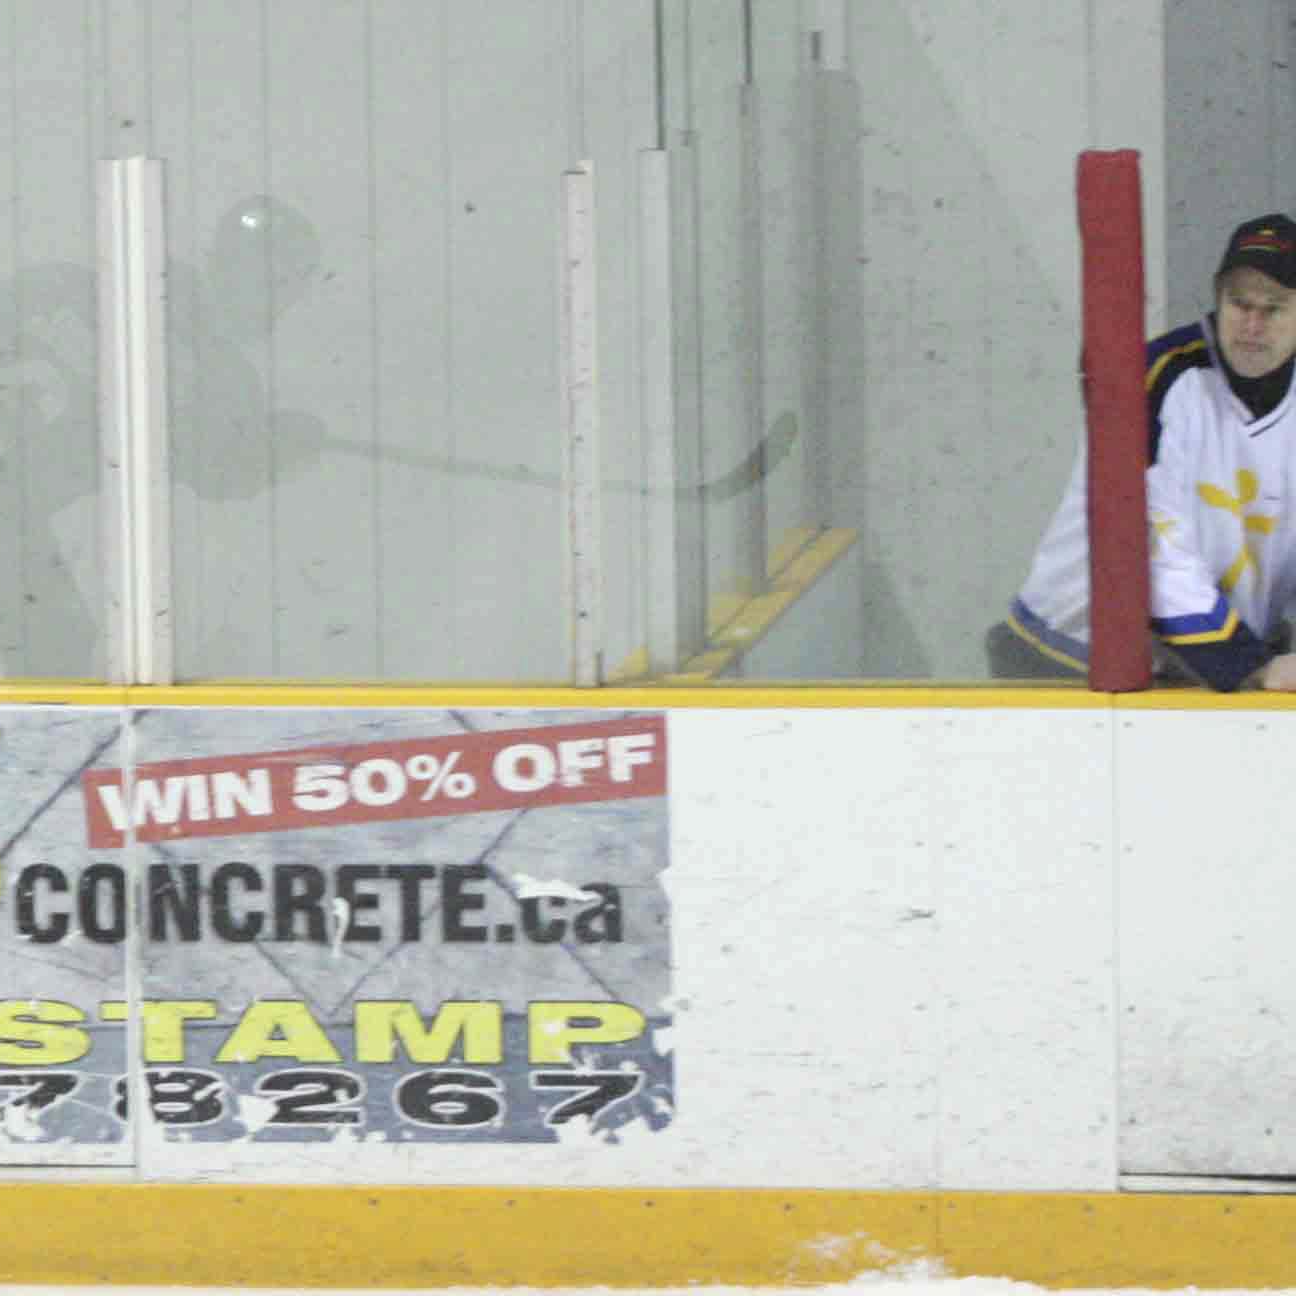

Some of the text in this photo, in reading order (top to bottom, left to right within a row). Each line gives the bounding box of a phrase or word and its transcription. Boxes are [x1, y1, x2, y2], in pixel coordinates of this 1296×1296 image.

[98, 733, 656, 832] WIN 50% OFF
